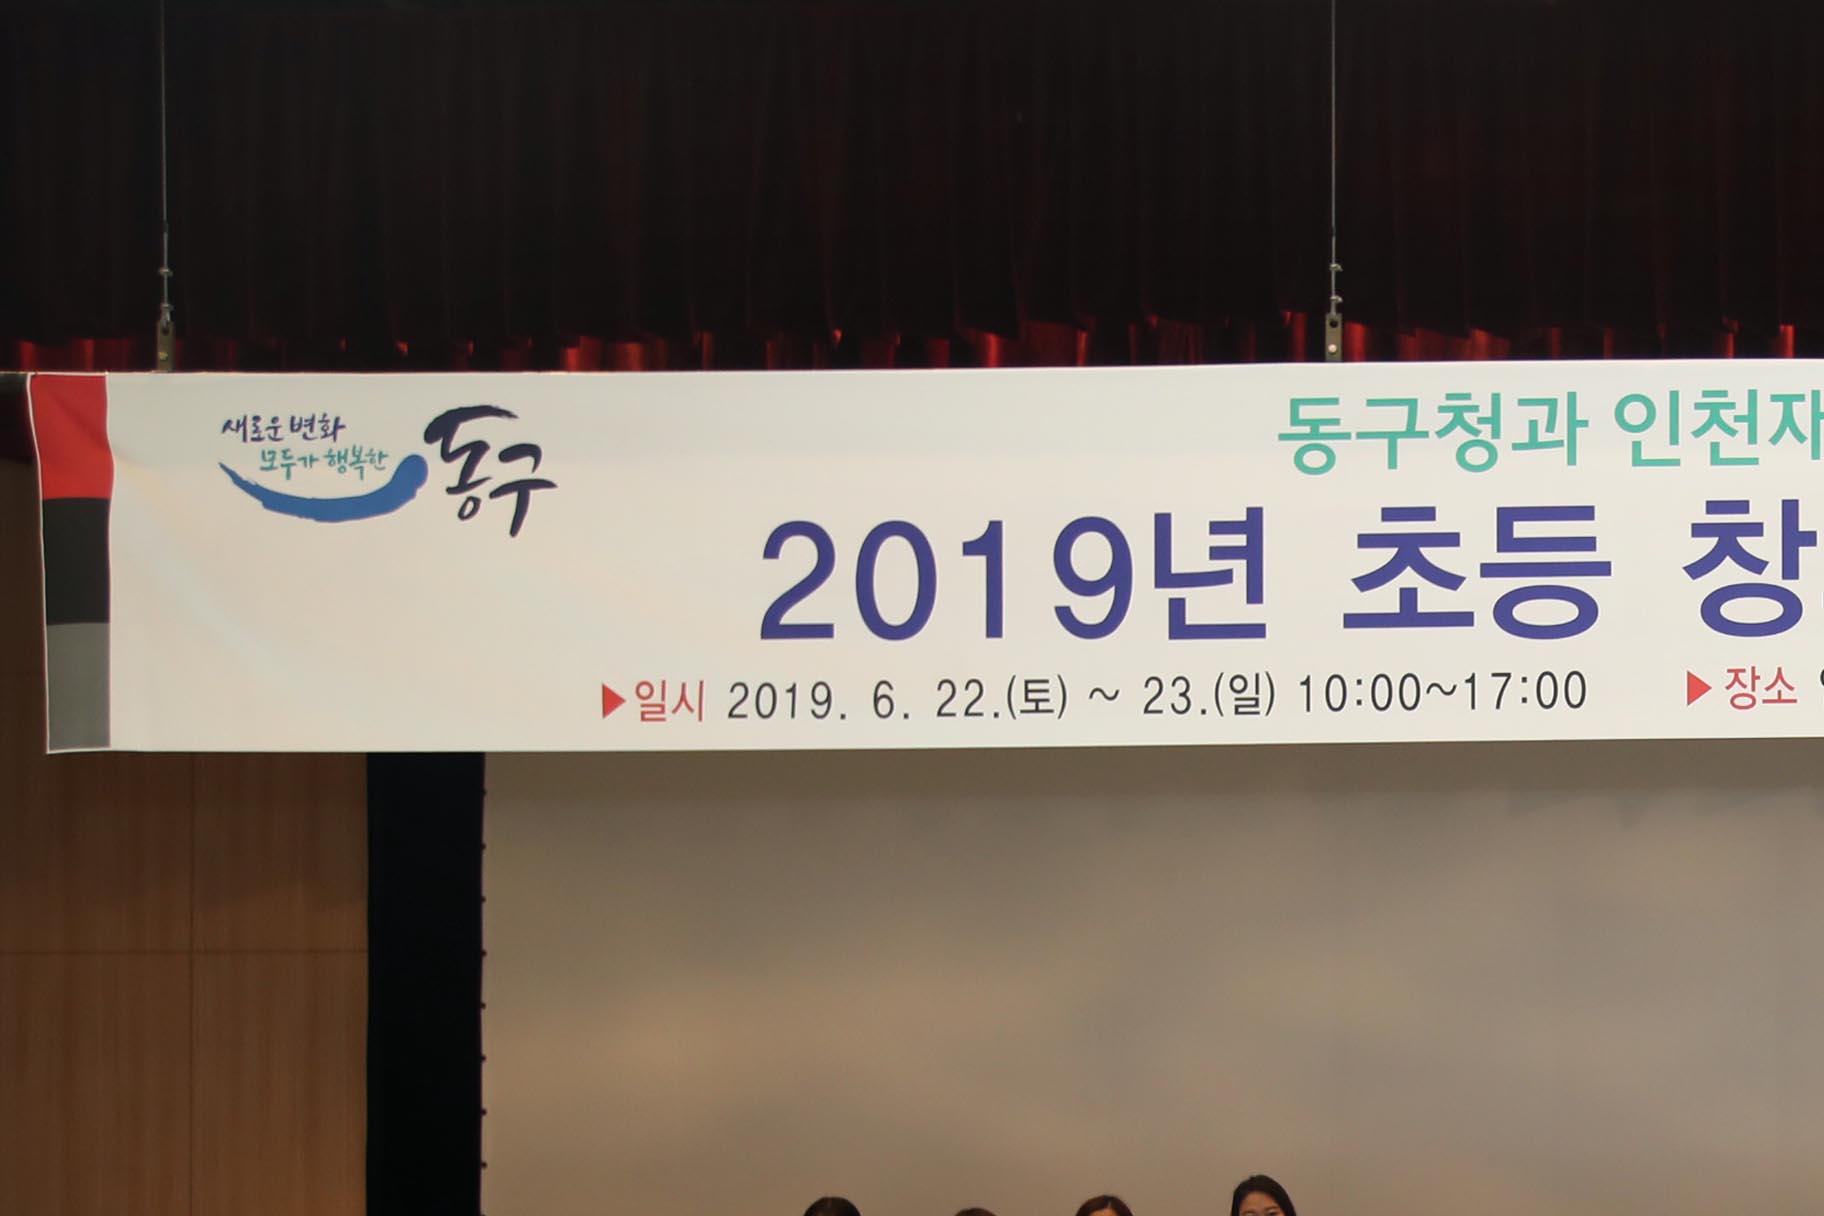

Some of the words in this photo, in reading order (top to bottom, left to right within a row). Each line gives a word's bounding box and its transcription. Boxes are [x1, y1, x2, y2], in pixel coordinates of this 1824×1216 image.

[221, 414, 284, 443] 새로운
[290, 413, 346, 443] 변화
[1278, 392, 1589, 475] 동구청과
[260, 448, 319, 480] 모두가
[324, 445, 389, 480] 행복한
[424, 405, 557, 537] 동구
[761, 507, 1266, 641] 2019년
[1343, 505, 1611, 640] 초등
[635, 680, 704, 722] 일시
[728, 681, 846, 720] 2019.
[873, 680, 909, 719] 6.
[937, 674, 1066, 720] 22.(토)
[1144, 671, 1274, 716] 23.(일)
[1300, 671, 1586, 712] 10:00~17:00
[1725, 666, 1797, 710] 장소
